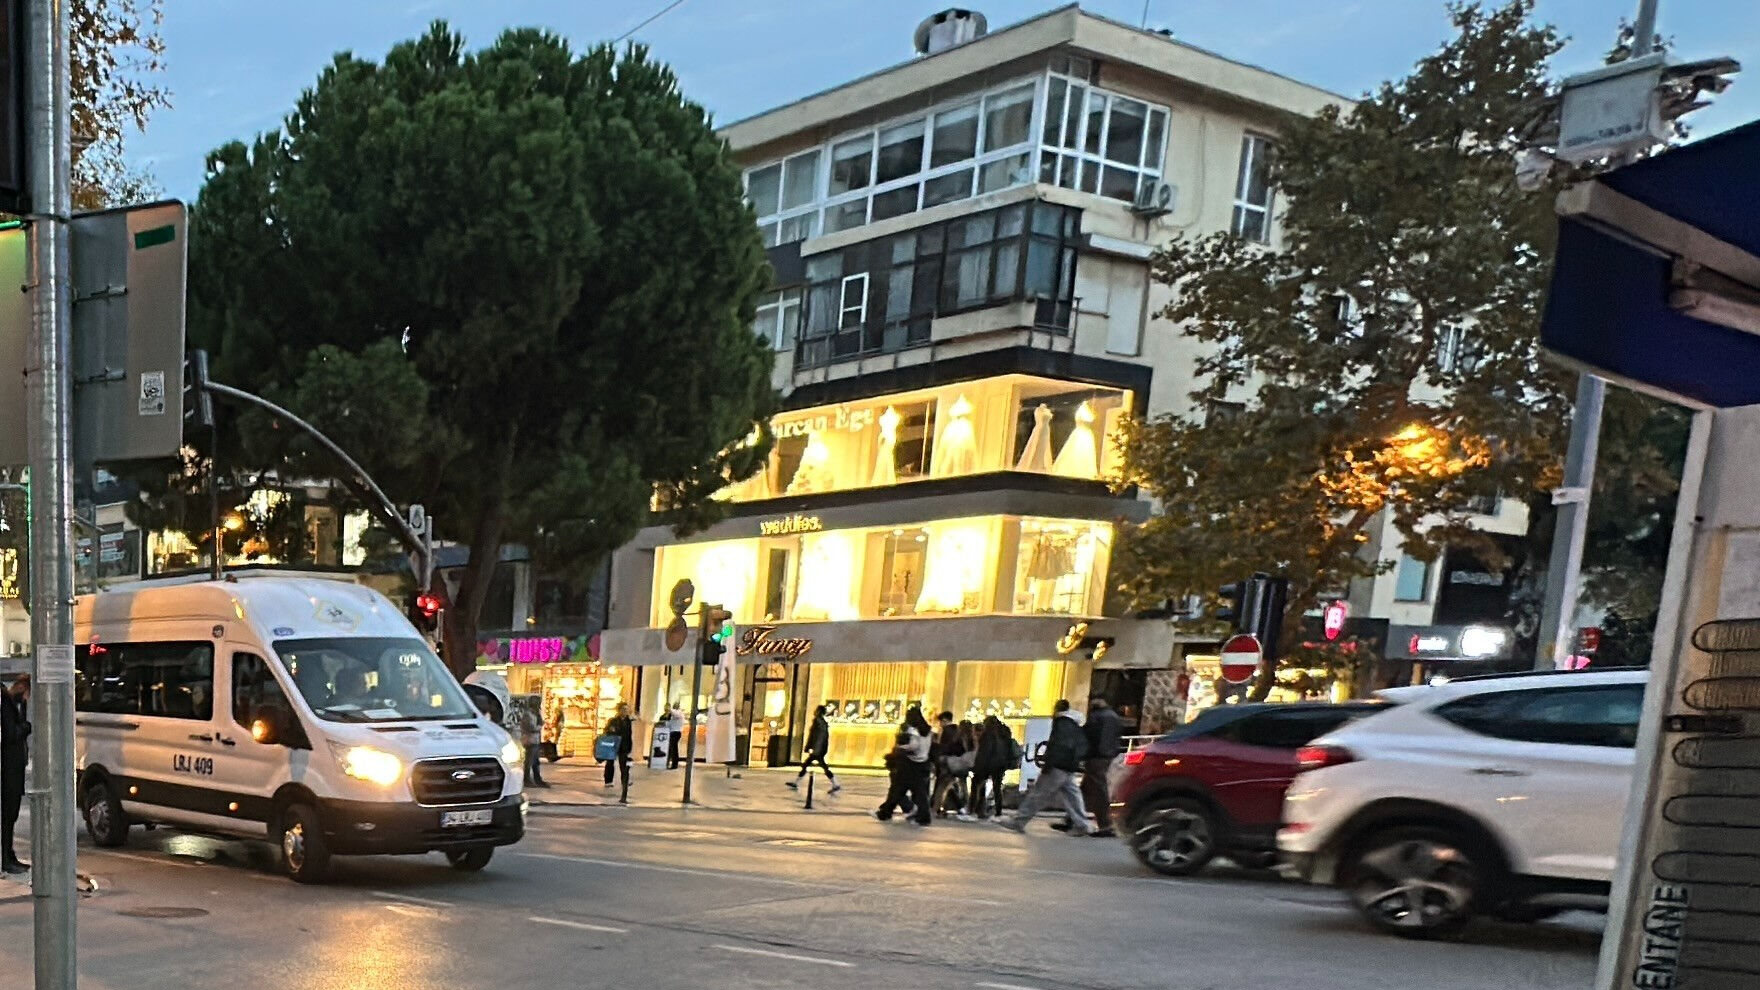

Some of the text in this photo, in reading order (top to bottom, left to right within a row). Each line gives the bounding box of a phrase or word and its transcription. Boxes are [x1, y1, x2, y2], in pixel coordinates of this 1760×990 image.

[770, 415, 829, 439] urcan
[173, 753, 213, 775] LRJ 409
